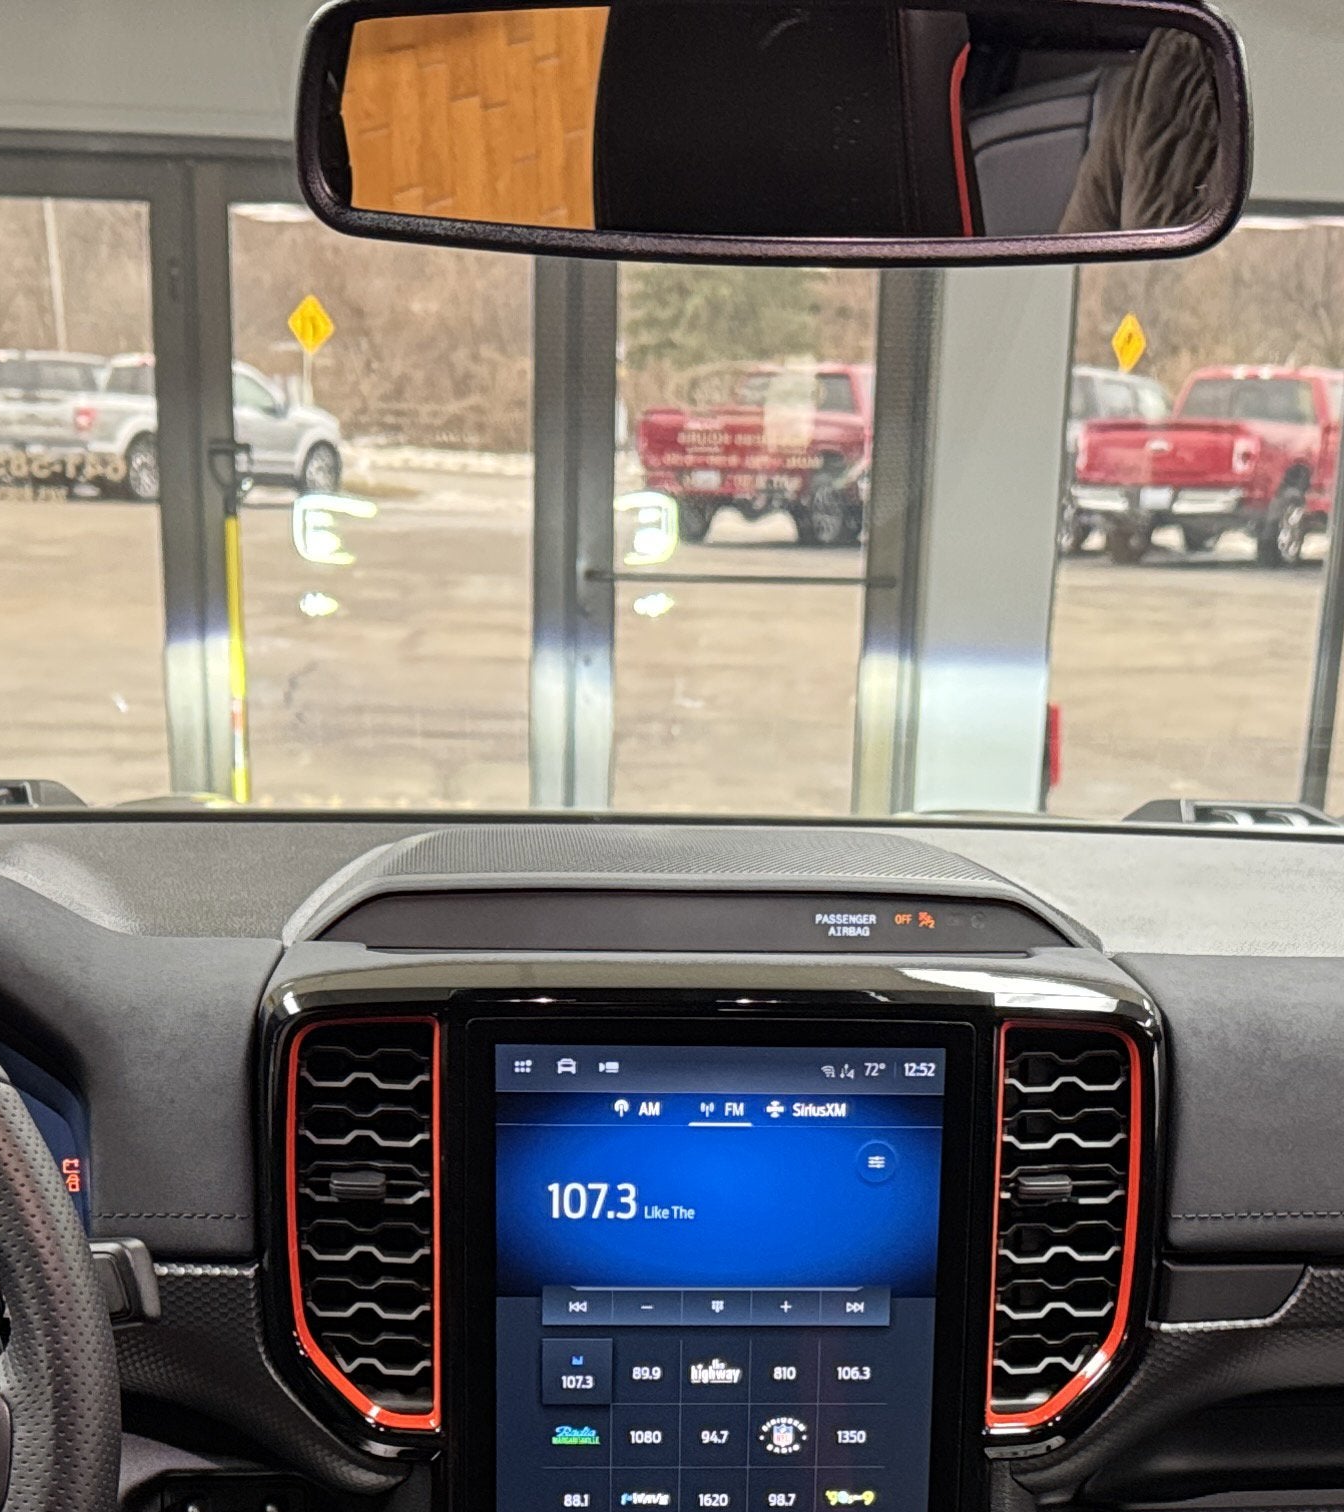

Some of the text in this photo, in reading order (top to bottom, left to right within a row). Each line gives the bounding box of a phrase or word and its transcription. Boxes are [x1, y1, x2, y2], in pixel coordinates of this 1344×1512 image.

[814, 913, 913, 925] PASSENGER OFF
[827, 926, 871, 937] AIRBAG
[903, 1063, 936, 1078] 12:52
[638, 1101, 661, 1116] AM
[724, 1102, 745, 1117] FM
[792, 1101, 847, 1117] SiriusXM
[547, 1182, 696, 1220] 107.3 Like The
[632, 1366, 662, 1380] 89.9
[690, 1363, 742, 1383] highway
[772, 1366, 796, 1380] 810
[836, 1366, 871, 1380] 106.3
[561, 1375, 594, 1390] 107.3
[629, 1430, 662, 1444] 1080
[701, 1430, 729, 1444] 94.7
[836, 1430, 866, 1444] 1350
[563, 1494, 590, 1508] 88.1
[698, 1493, 729, 1507] 1620
[768, 1493, 796, 1507] 98.7
